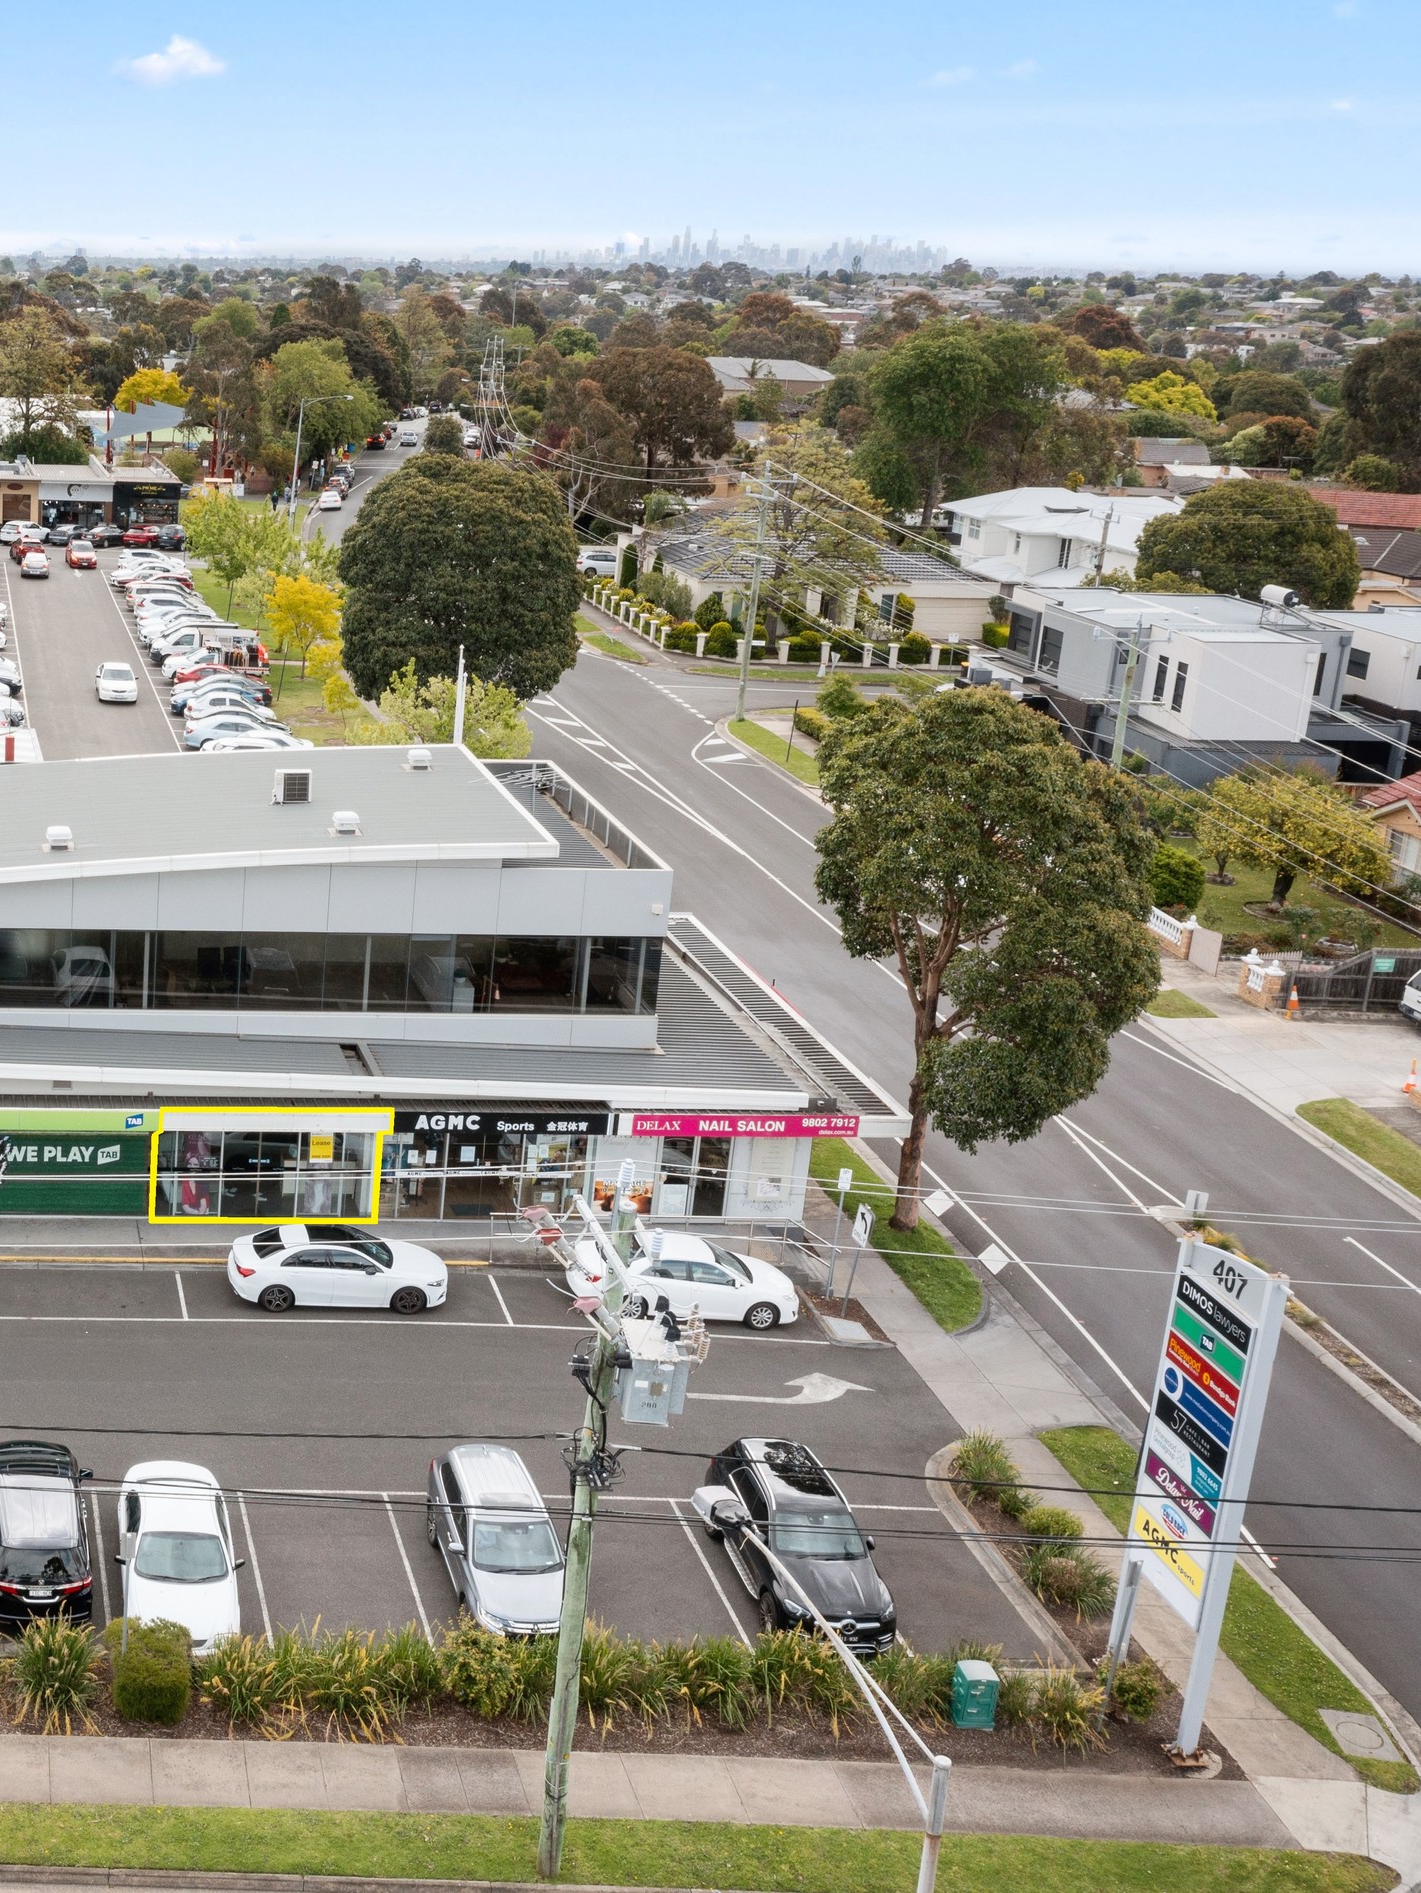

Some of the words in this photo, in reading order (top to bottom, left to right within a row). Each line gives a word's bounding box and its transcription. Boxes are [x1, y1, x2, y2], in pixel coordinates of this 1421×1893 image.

[127, 1117, 142, 1125] TAB
[415, 1114, 481, 1131] AGMC
[496, 1120, 535, 1132] Sports
[546, 1121, 589, 1132] 金冠体育
[636, 1120, 682, 1131] DELAX
[698, 1120, 733, 1132] NAIL
[737, 1120, 785, 1132] SALON
[802, 1118, 827, 1127] 9802
[830, 1118, 856, 1127] 7912
[7, 1146, 39, 1162] WE
[43, 1146, 95, 1162] PLAY
[100, 1151, 119, 1159] TAB
[1213, 1259, 1248, 1300] 407
[1182, 1281, 1214, 1315] DIMOS
[1213, 1305, 1246, 1343] lawyers
[1202, 1335, 1213, 1351] TAB
[1169, 1338, 1202, 1373] Pinewood
[1170, 1409, 1188, 1433] 57
[1183, 1430, 1211, 1458] RESTAURANT
[1186, 1424, 1198, 1439] CAFE
[1201, 1439, 1211, 1450] BAR
[1180, 1496, 1205, 1522] Nail
[1162, 1508, 1174, 1525] COLD
[1173, 1518, 1186, 1536] ROCK
[1142, 1519, 1179, 1564] AGMC
[1177, 1564, 1195, 1586] sports
